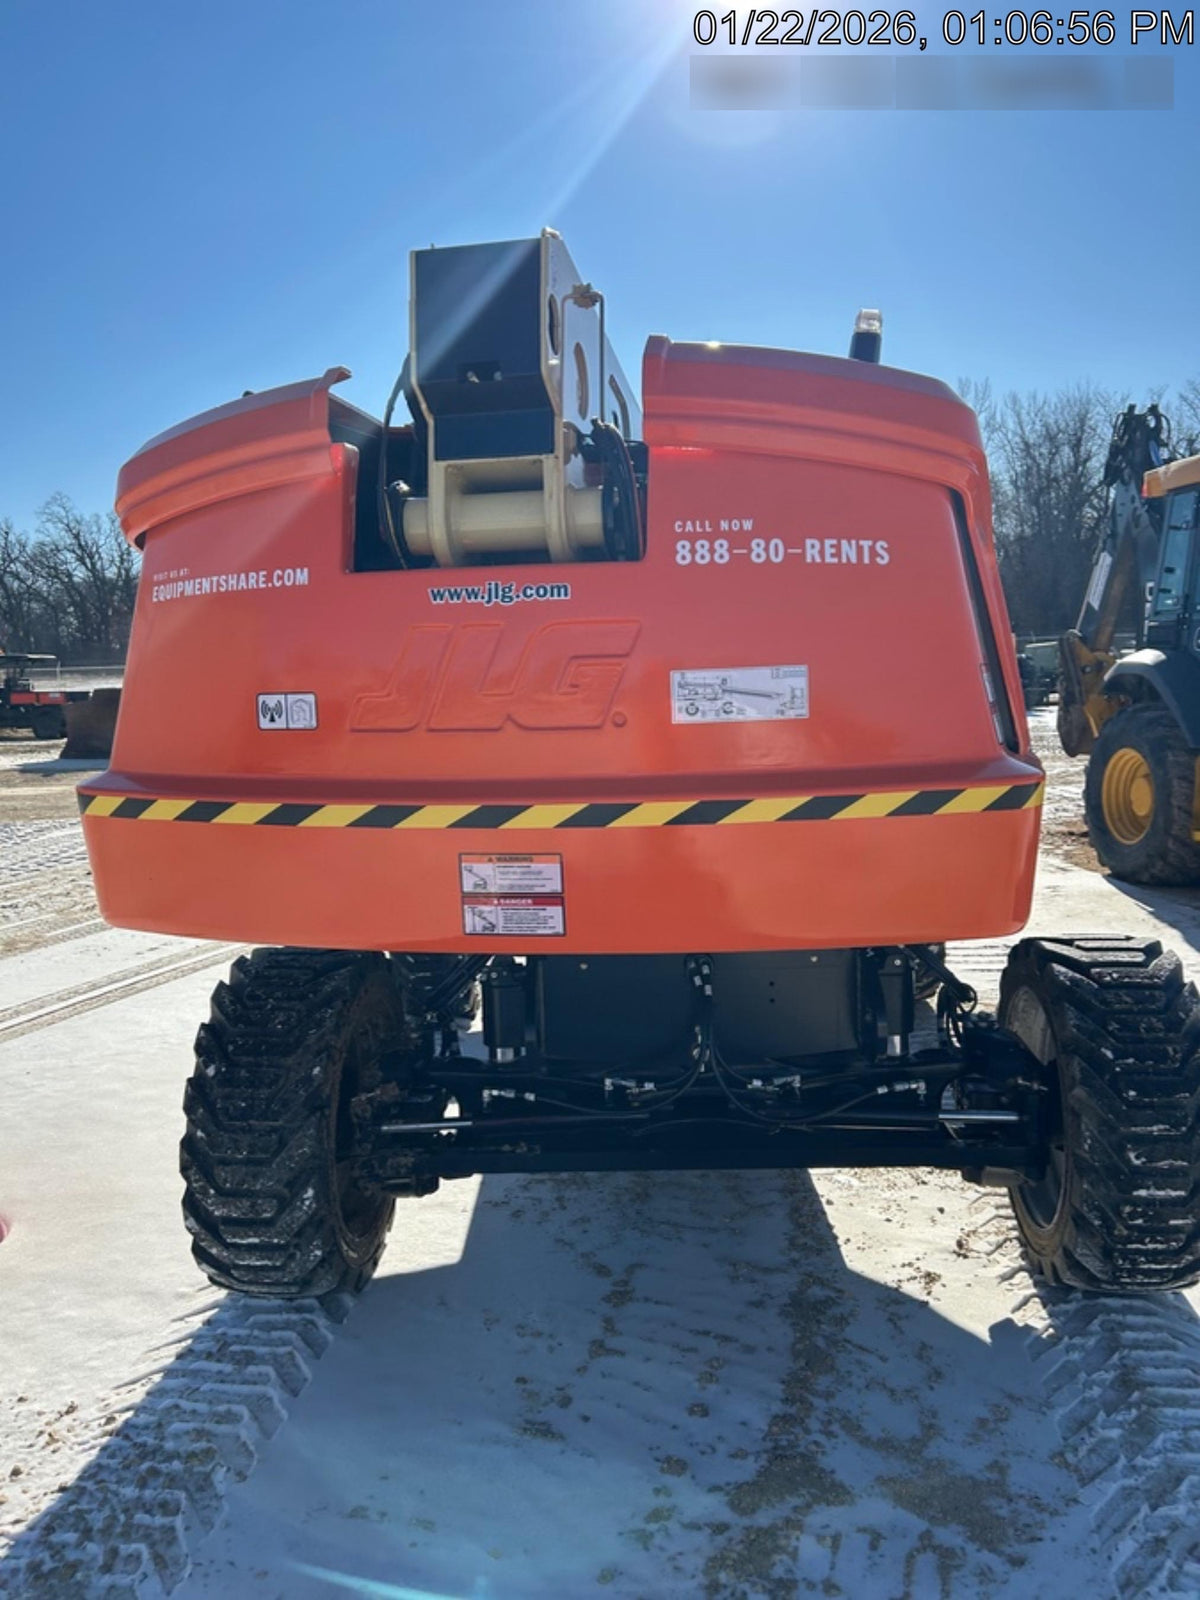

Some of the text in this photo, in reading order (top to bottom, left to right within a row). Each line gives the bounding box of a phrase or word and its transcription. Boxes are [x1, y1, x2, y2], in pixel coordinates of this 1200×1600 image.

[675, 519, 753, 532] CALL NOW
[152, 567, 309, 603] EQUIPMENTSHARE.COM
[429, 581, 571, 606] www.jlg.com
